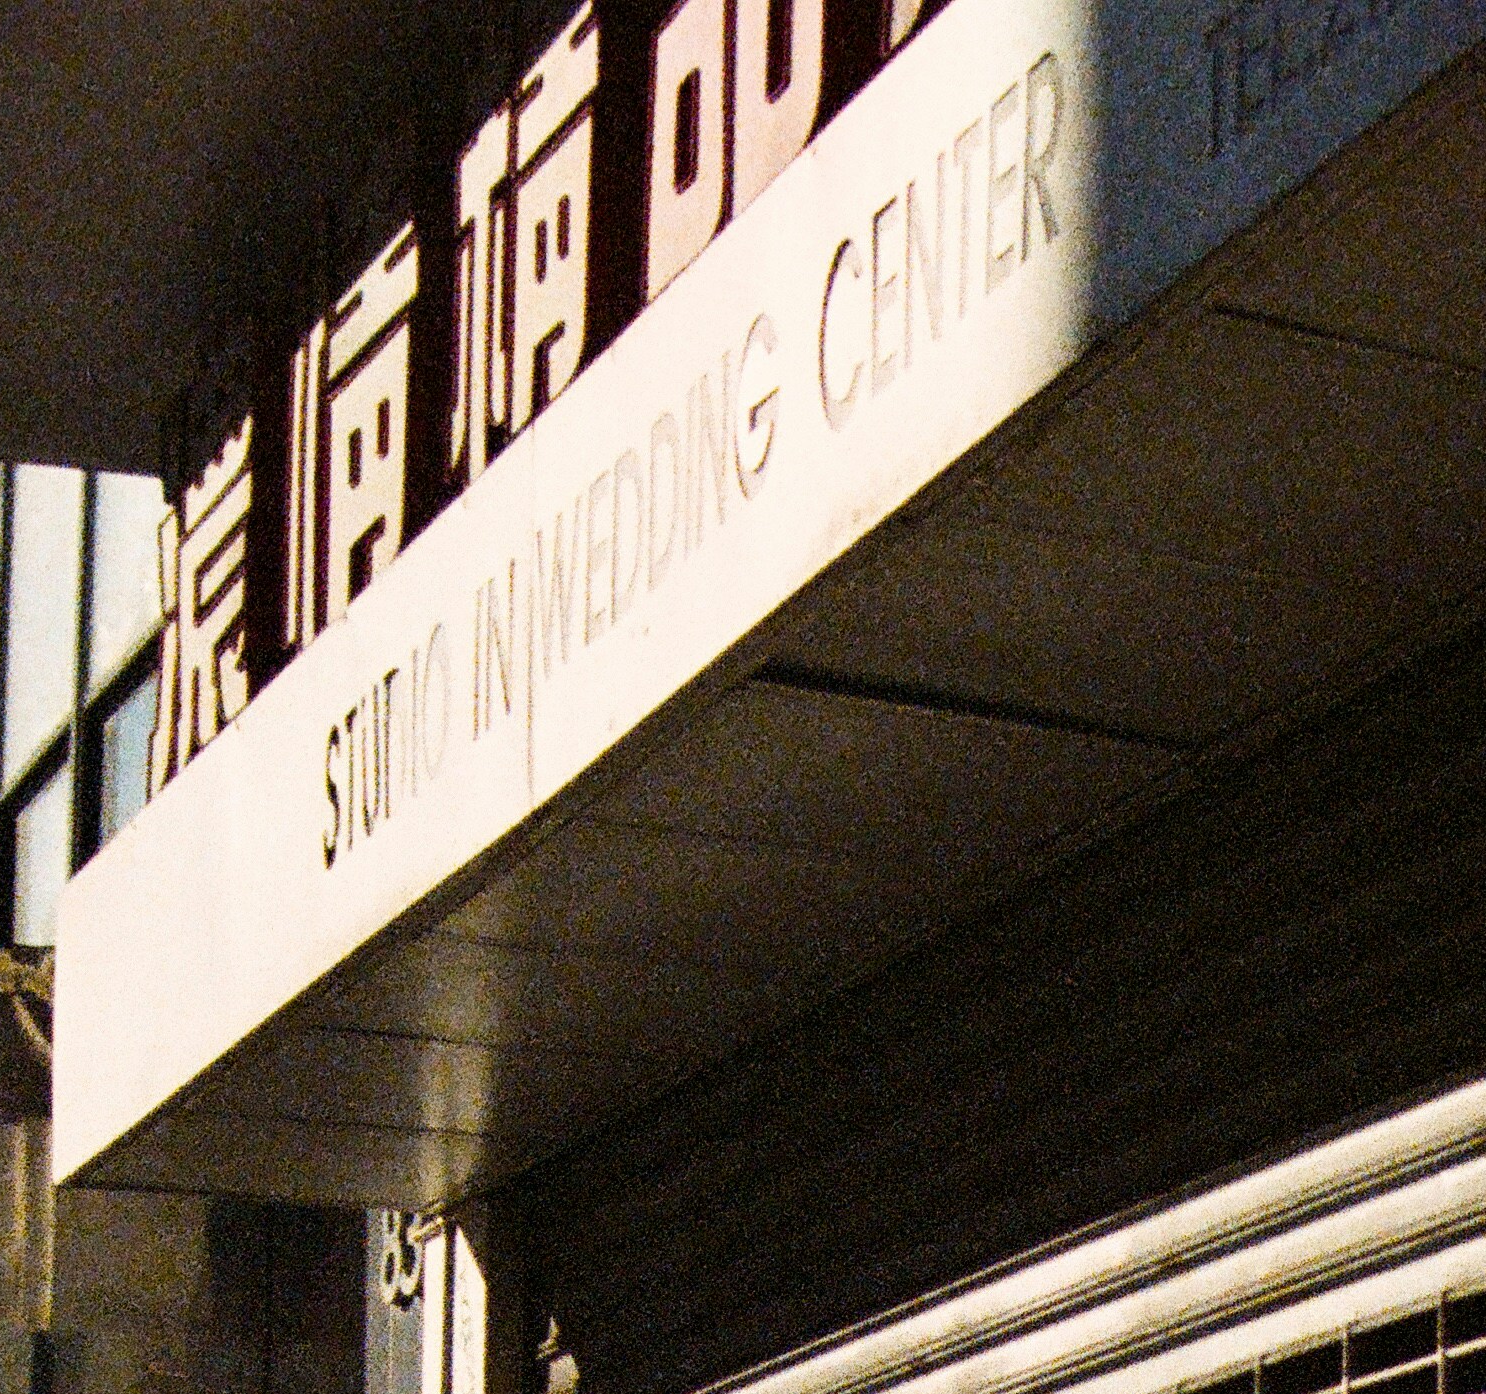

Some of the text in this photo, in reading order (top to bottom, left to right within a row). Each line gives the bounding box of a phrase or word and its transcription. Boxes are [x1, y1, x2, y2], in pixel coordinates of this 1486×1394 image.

[472, 556, 518, 742] IN
[532, 312, 782, 682] WEDDING
[819, 50, 1060, 434] CENTER
